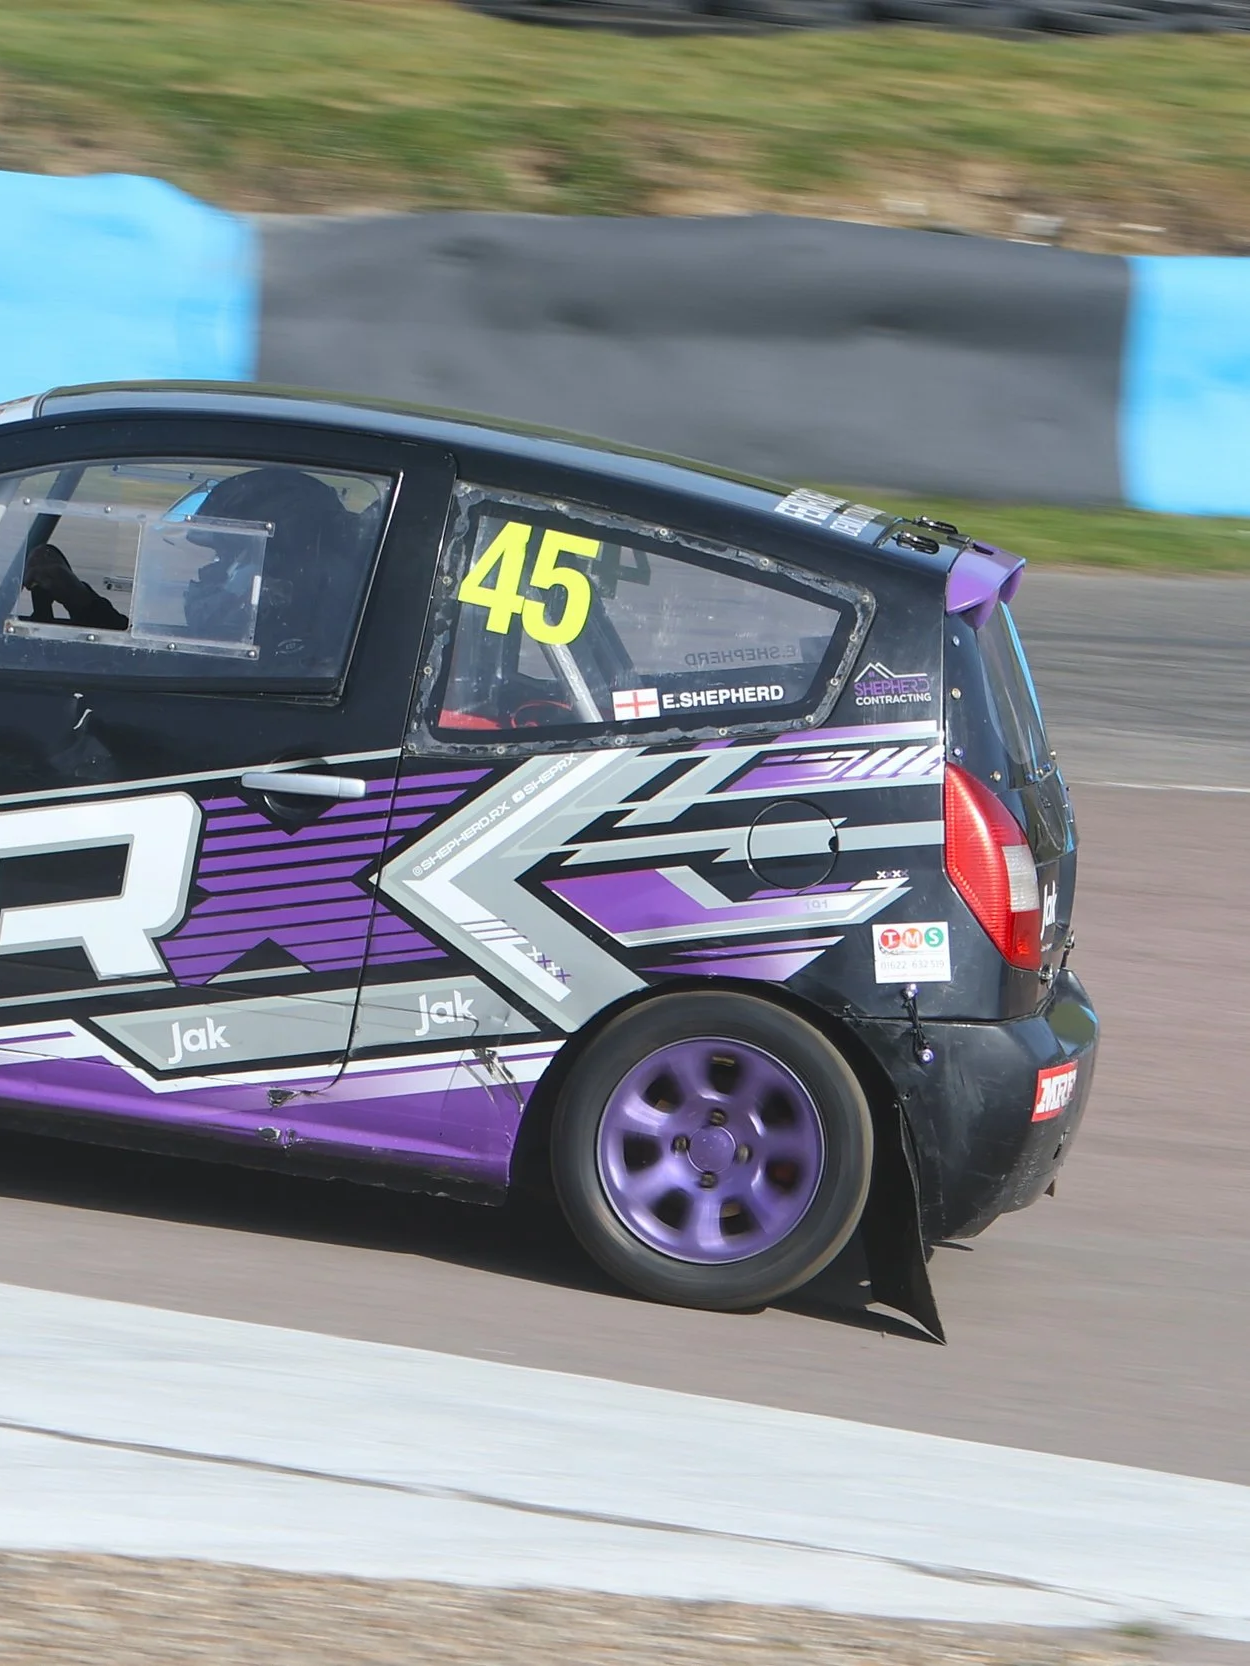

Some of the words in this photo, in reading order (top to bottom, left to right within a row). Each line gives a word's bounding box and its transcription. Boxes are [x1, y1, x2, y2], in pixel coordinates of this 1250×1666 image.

[458, 521, 600, 645] 45
[662, 685, 784, 709] E.SHEPHERD
[854, 678, 930, 696] SHEPHERD
[856, 693, 931, 706] CONTRACTING
[882, 929, 942, 947] TMS
[415, 990, 475, 1036] Jak
[168, 1017, 230, 1065] Jak
